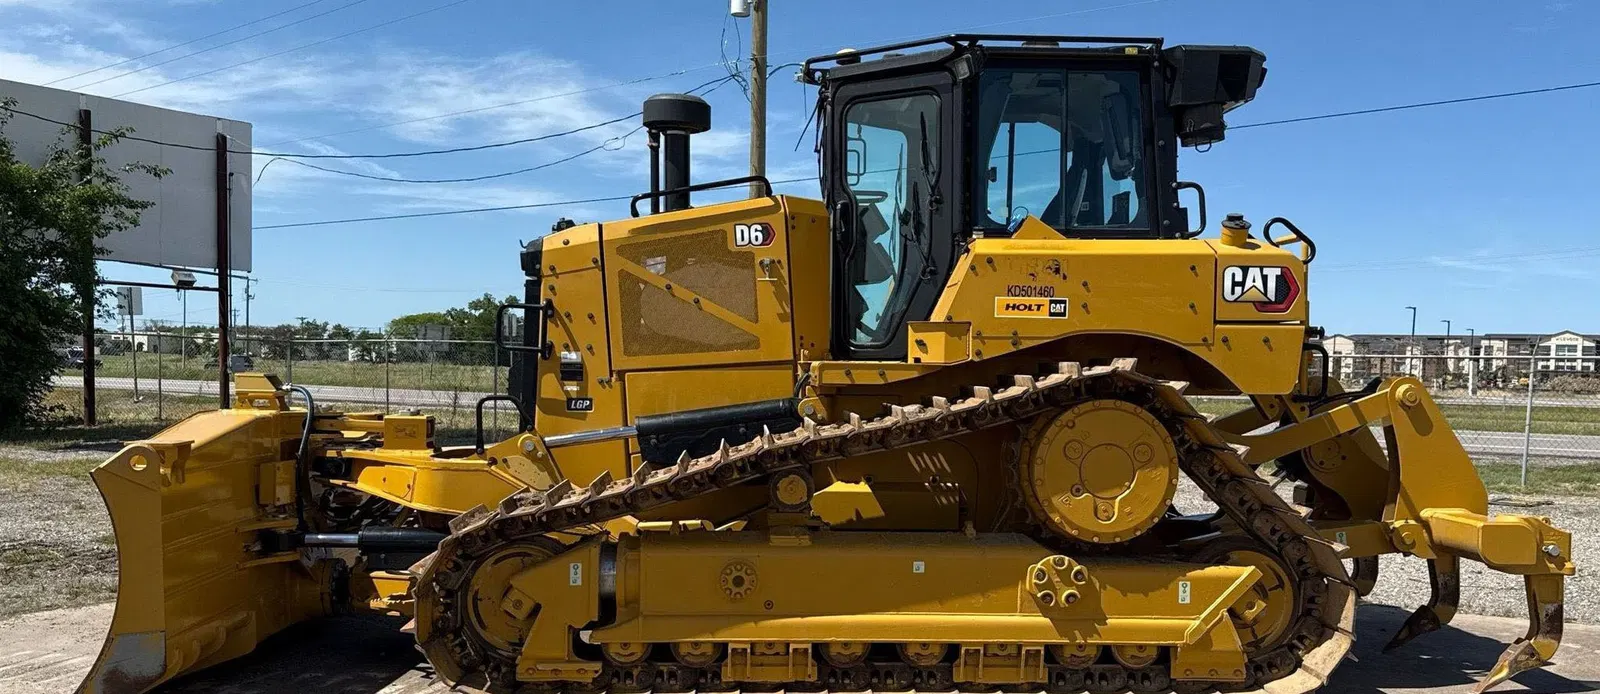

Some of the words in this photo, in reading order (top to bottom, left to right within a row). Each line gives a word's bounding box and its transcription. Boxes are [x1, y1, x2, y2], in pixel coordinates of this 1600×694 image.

[735, 223, 763, 246] D6
[1007, 284, 1055, 298] KD501460
[1223, 266, 1282, 302] CAT
[1004, 303, 1045, 312] HOLT
[1050, 303, 1066, 313] CAT
[570, 400, 590, 409] LGP
